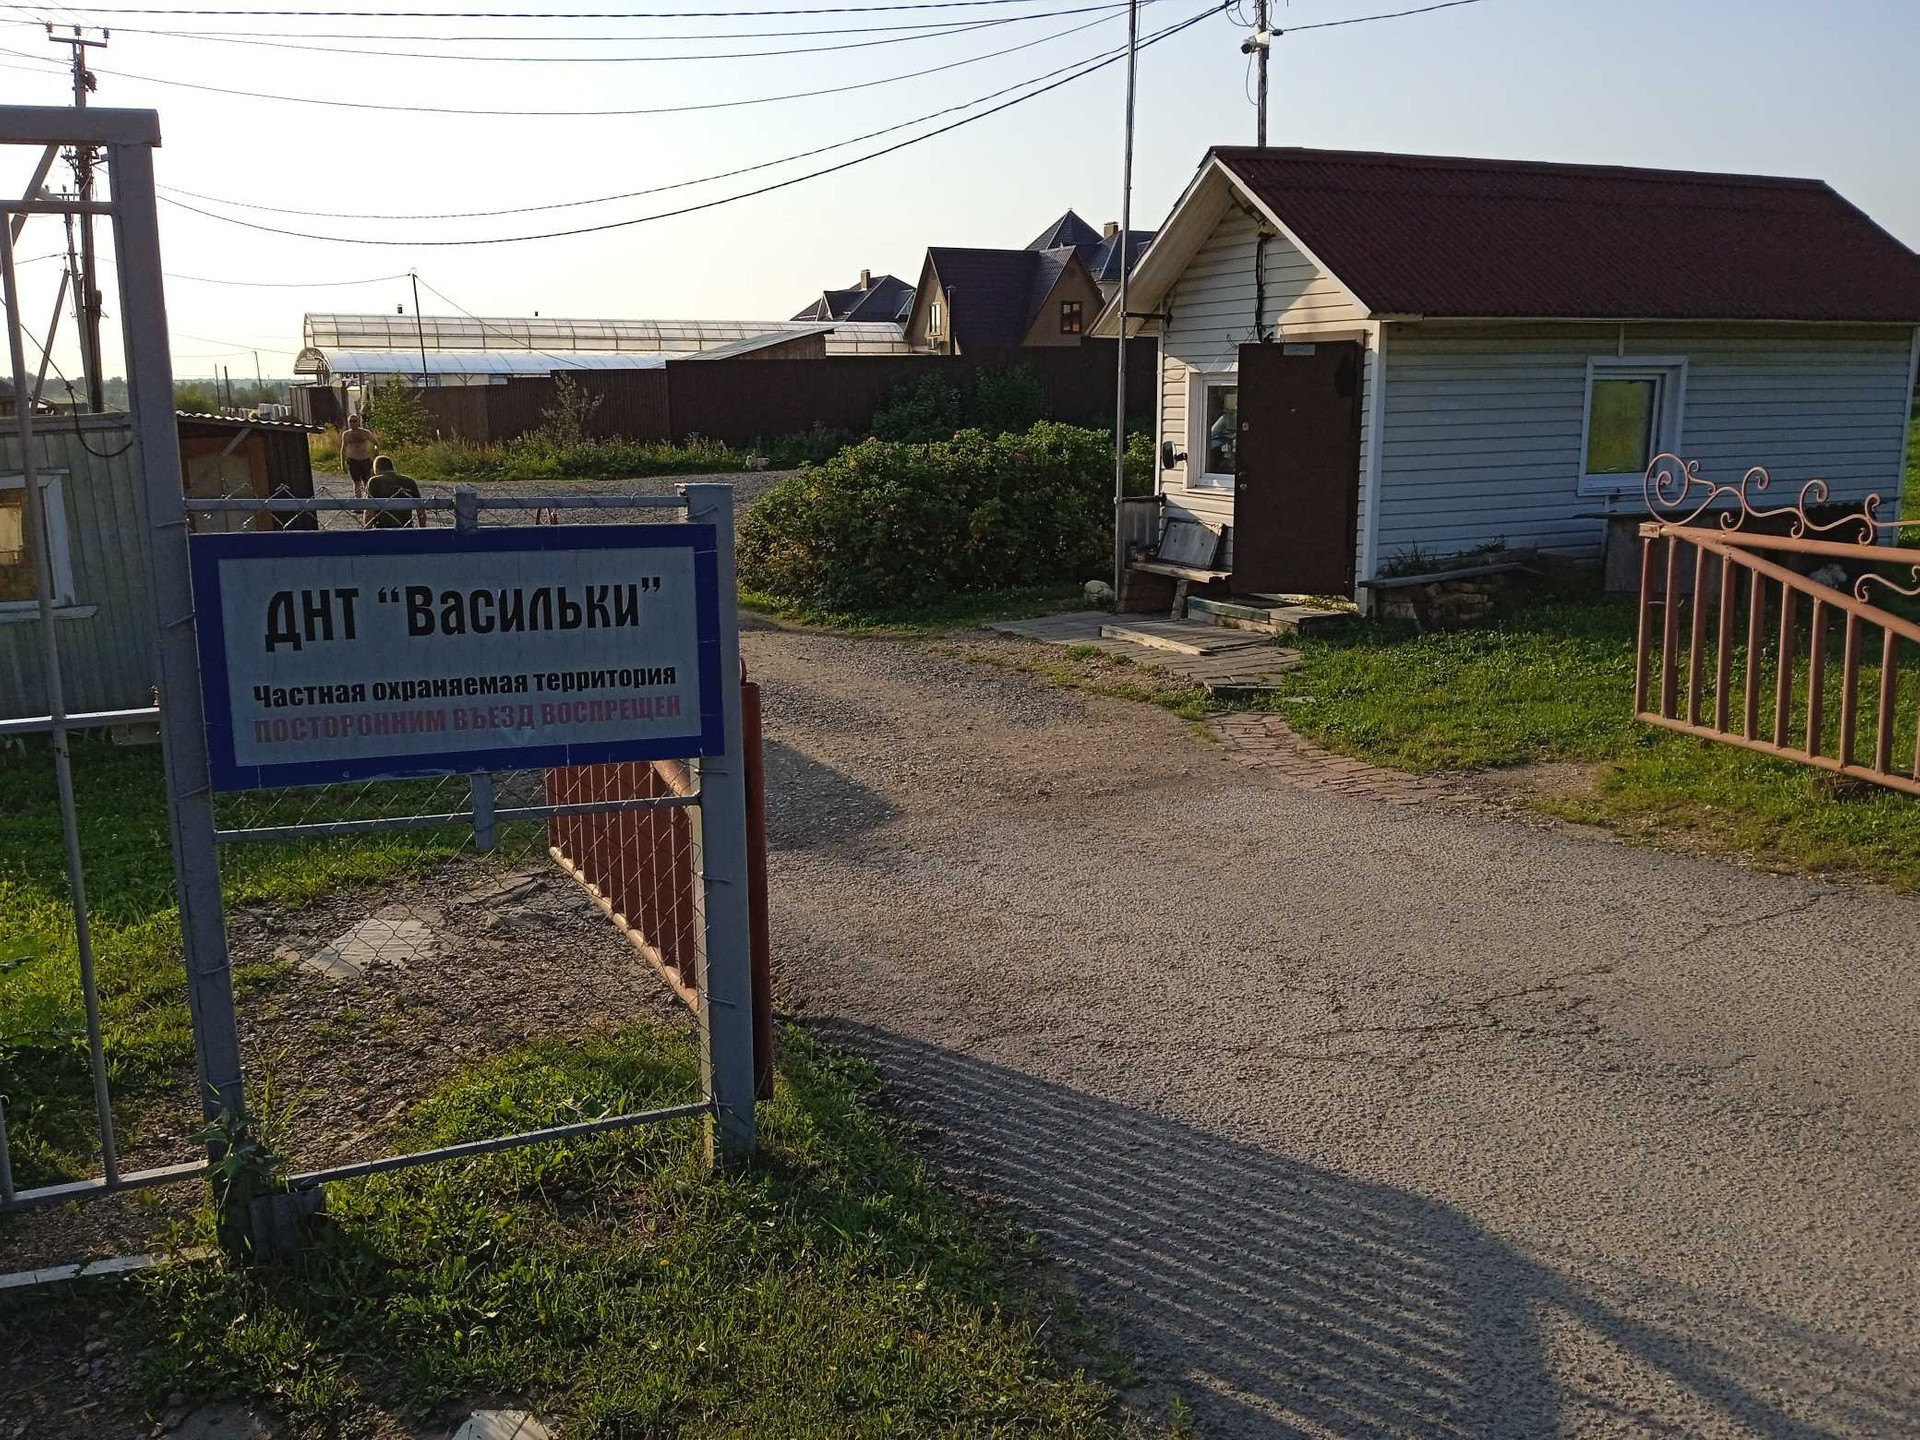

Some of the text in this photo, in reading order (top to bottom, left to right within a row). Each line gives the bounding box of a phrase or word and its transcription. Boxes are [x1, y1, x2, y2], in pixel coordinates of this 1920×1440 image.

[264, 587, 360, 653] ДНТ
[253, 665, 677, 709] Частная охраняемая территория
[254, 694, 681, 744] ПОСТОРОННИМ ВЪЕЗД ВОСПРЕЩЕН
